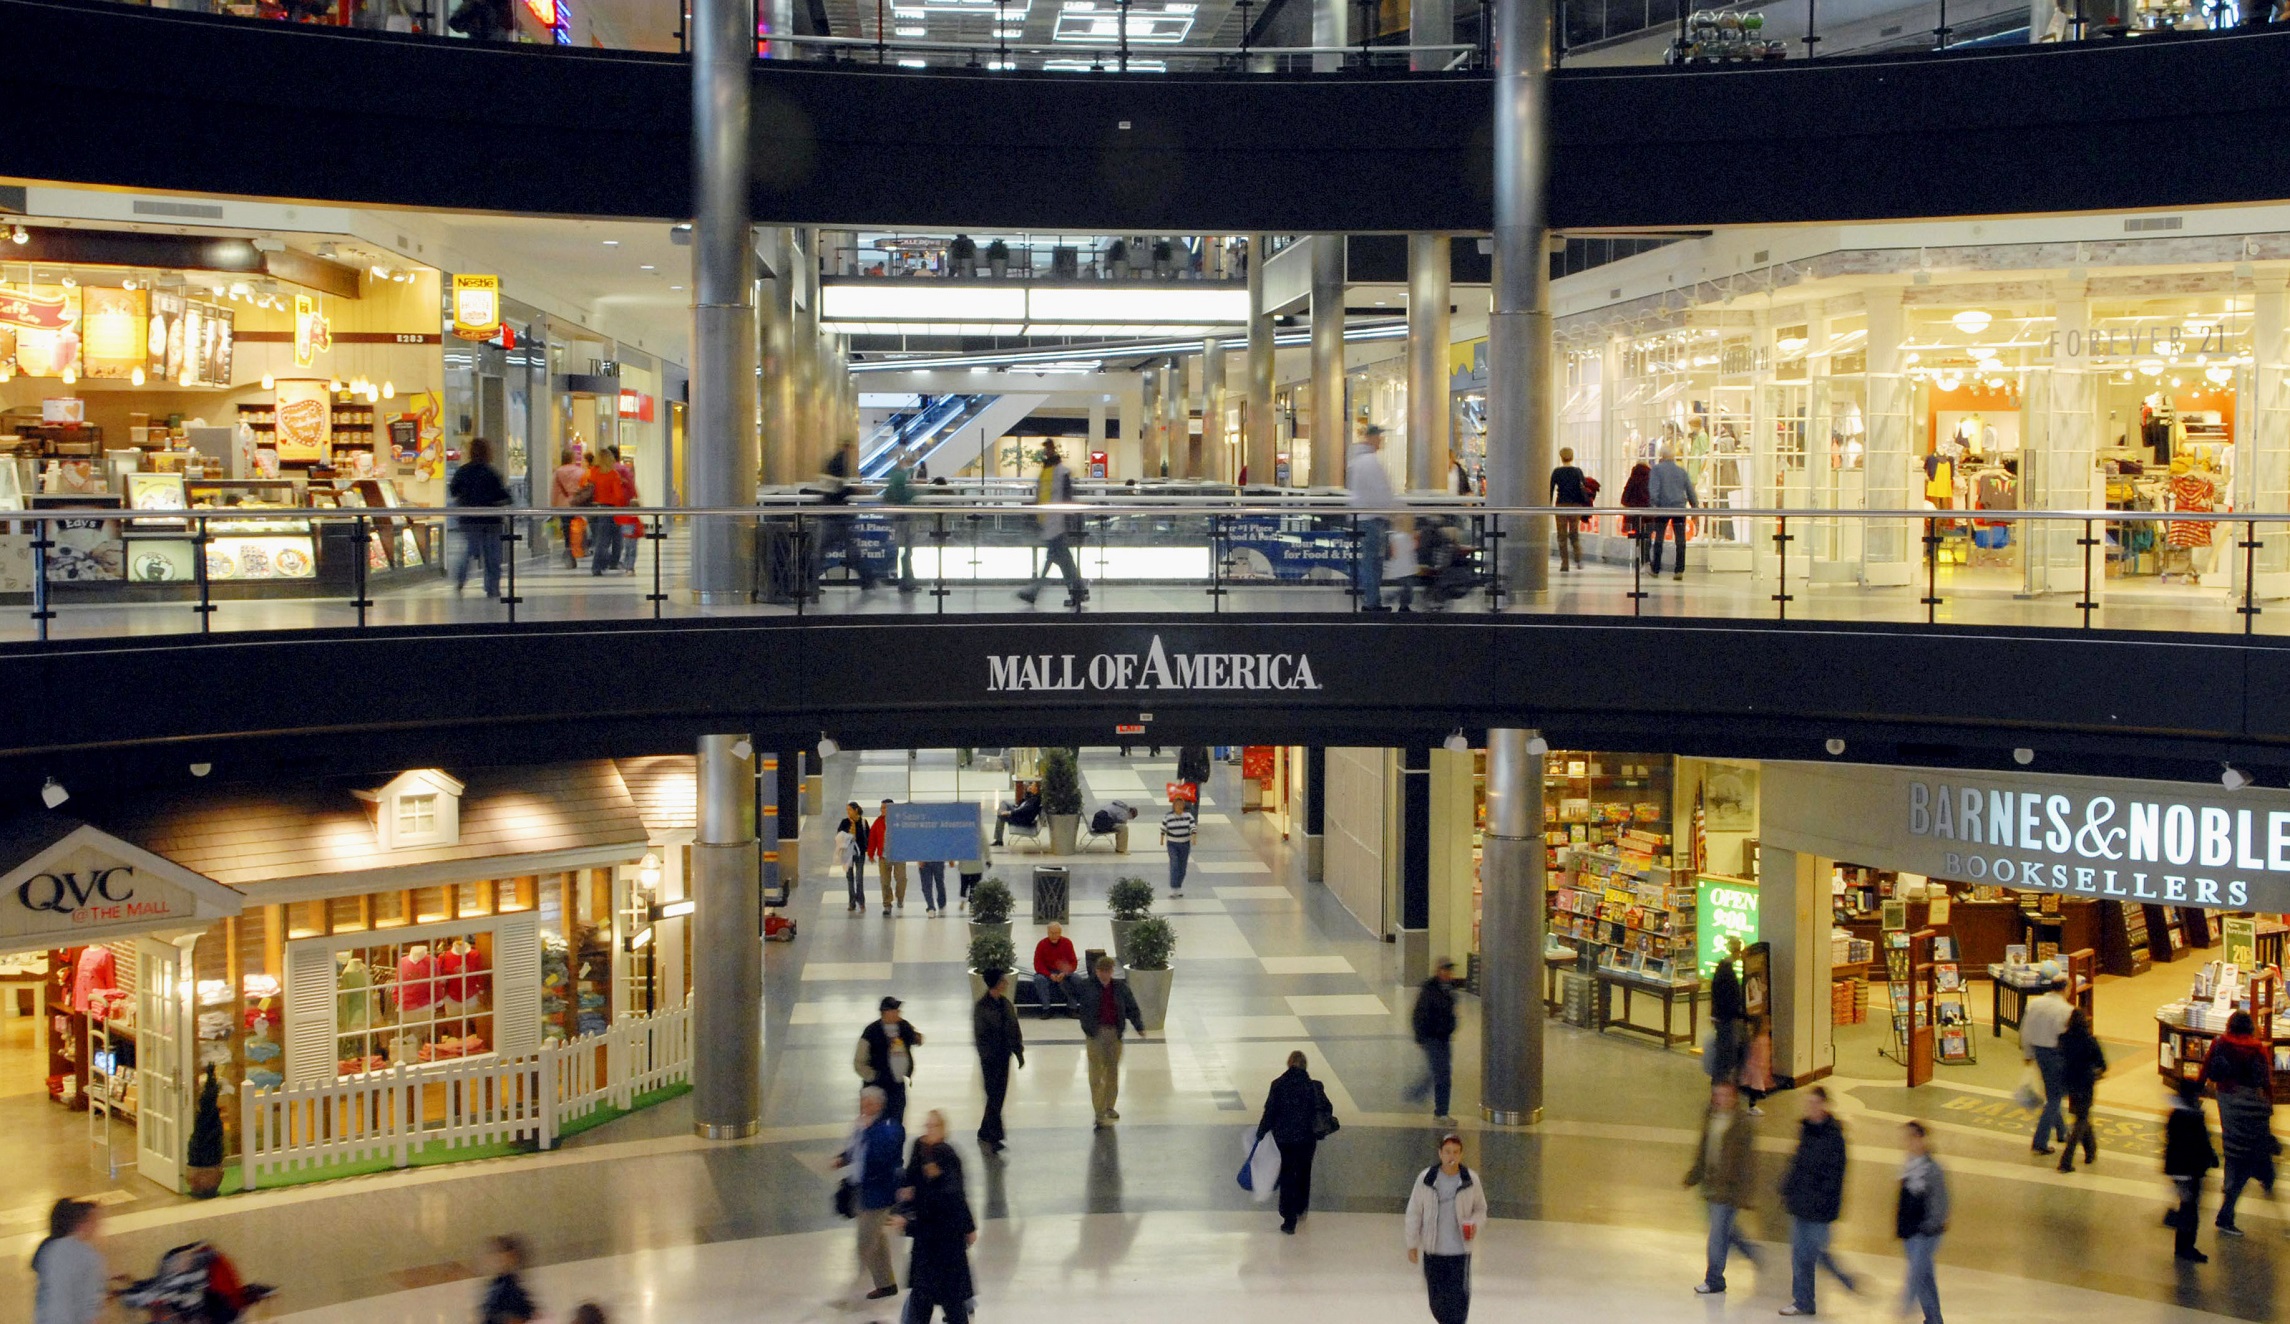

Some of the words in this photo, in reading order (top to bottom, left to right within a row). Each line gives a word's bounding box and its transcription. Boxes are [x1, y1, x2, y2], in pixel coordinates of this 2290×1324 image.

[396, 334, 424, 343] E283
[2050, 326, 2182, 357] FOREVER
[2200, 325, 2224, 354] 21
[1250, 524, 1274, 532] Place
[1283, 550, 1300, 559] for
[1303, 550, 1328, 559] Food
[1330, 550, 1342, 559] &
[987, 655, 1085, 691] MALL
[1089, 653, 1138, 690] OF
[1135, 634, 1320, 690] AMERICA
[1908, 781, 2072, 854] BARNES
[18, 866, 133, 914] QVC
[1944, 852, 2248, 907] BOOKSELLERS
[72, 907, 88, 923] @
[90, 905, 121, 920] THE
[127, 901, 170, 917] MALL
[1710, 887, 1759, 911] OPEN
